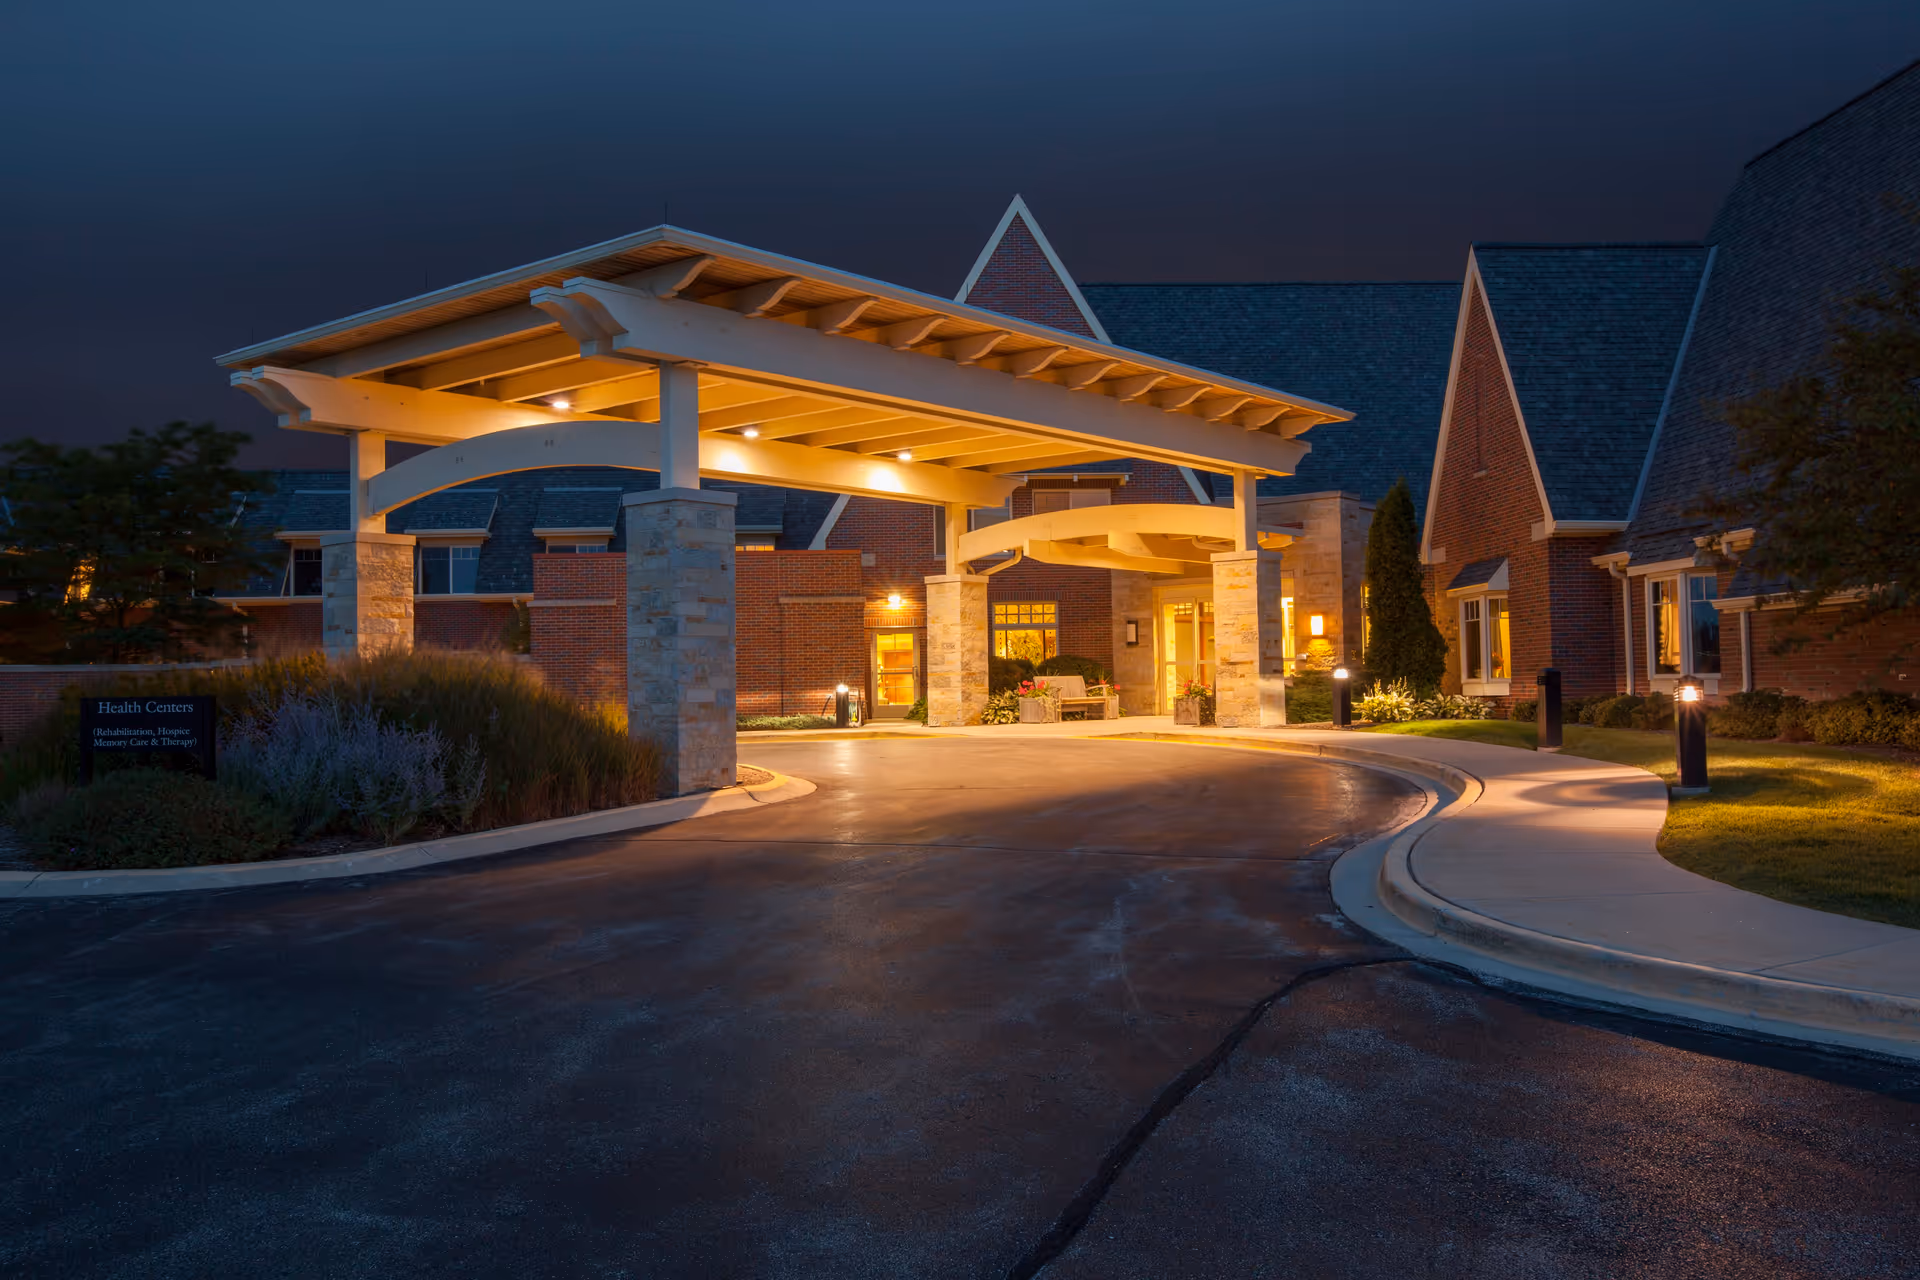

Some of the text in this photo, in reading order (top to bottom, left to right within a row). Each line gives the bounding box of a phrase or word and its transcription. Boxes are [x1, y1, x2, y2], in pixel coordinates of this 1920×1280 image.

[98, 701, 194, 713] Health Centers
[93, 727, 190, 737] (Rehabilitation, Hospice
[94, 737, 197, 748] Memory Care & Therapy)
